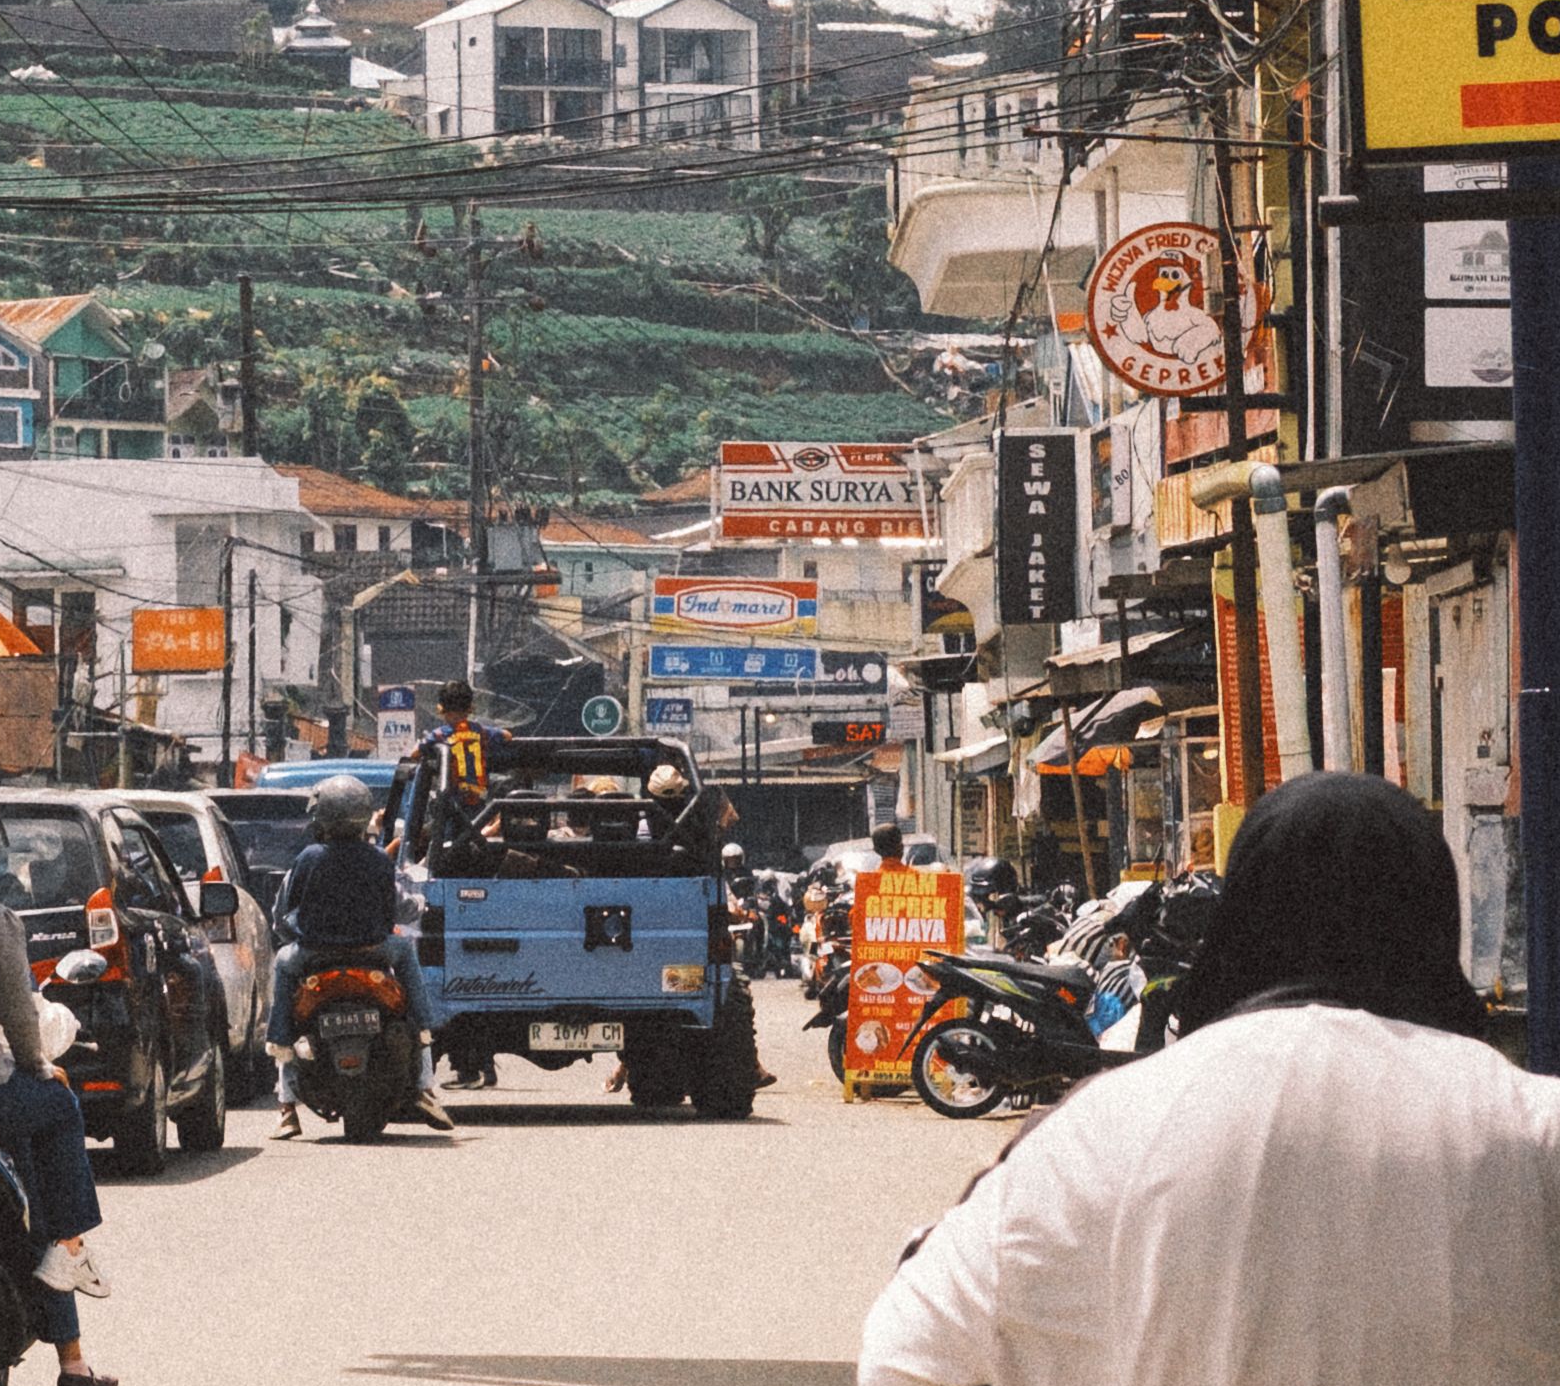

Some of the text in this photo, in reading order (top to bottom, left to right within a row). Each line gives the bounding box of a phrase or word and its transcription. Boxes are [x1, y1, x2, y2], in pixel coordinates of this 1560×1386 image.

[1144, 232, 1192, 253] FRIED
[1102, 244, 1145, 294] WIJAYA
[1121, 353, 1226, 385] GEPREK
[730, 480, 803, 502] BANK
[809, 480, 895, 503] SURYA
[1023, 443, 1052, 516] SEWA
[768, 520, 866, 534] CABANG
[1026, 532, 1047, 621] JAKET
[382, 722, 412, 735] ATM
[451, 740, 482, 778] 11
[879, 871, 938, 896] AYAM
[865, 895, 947, 919] GEPREK
[864, 917, 947, 944] WIJAYA
[531, 1024, 542, 1041] R
